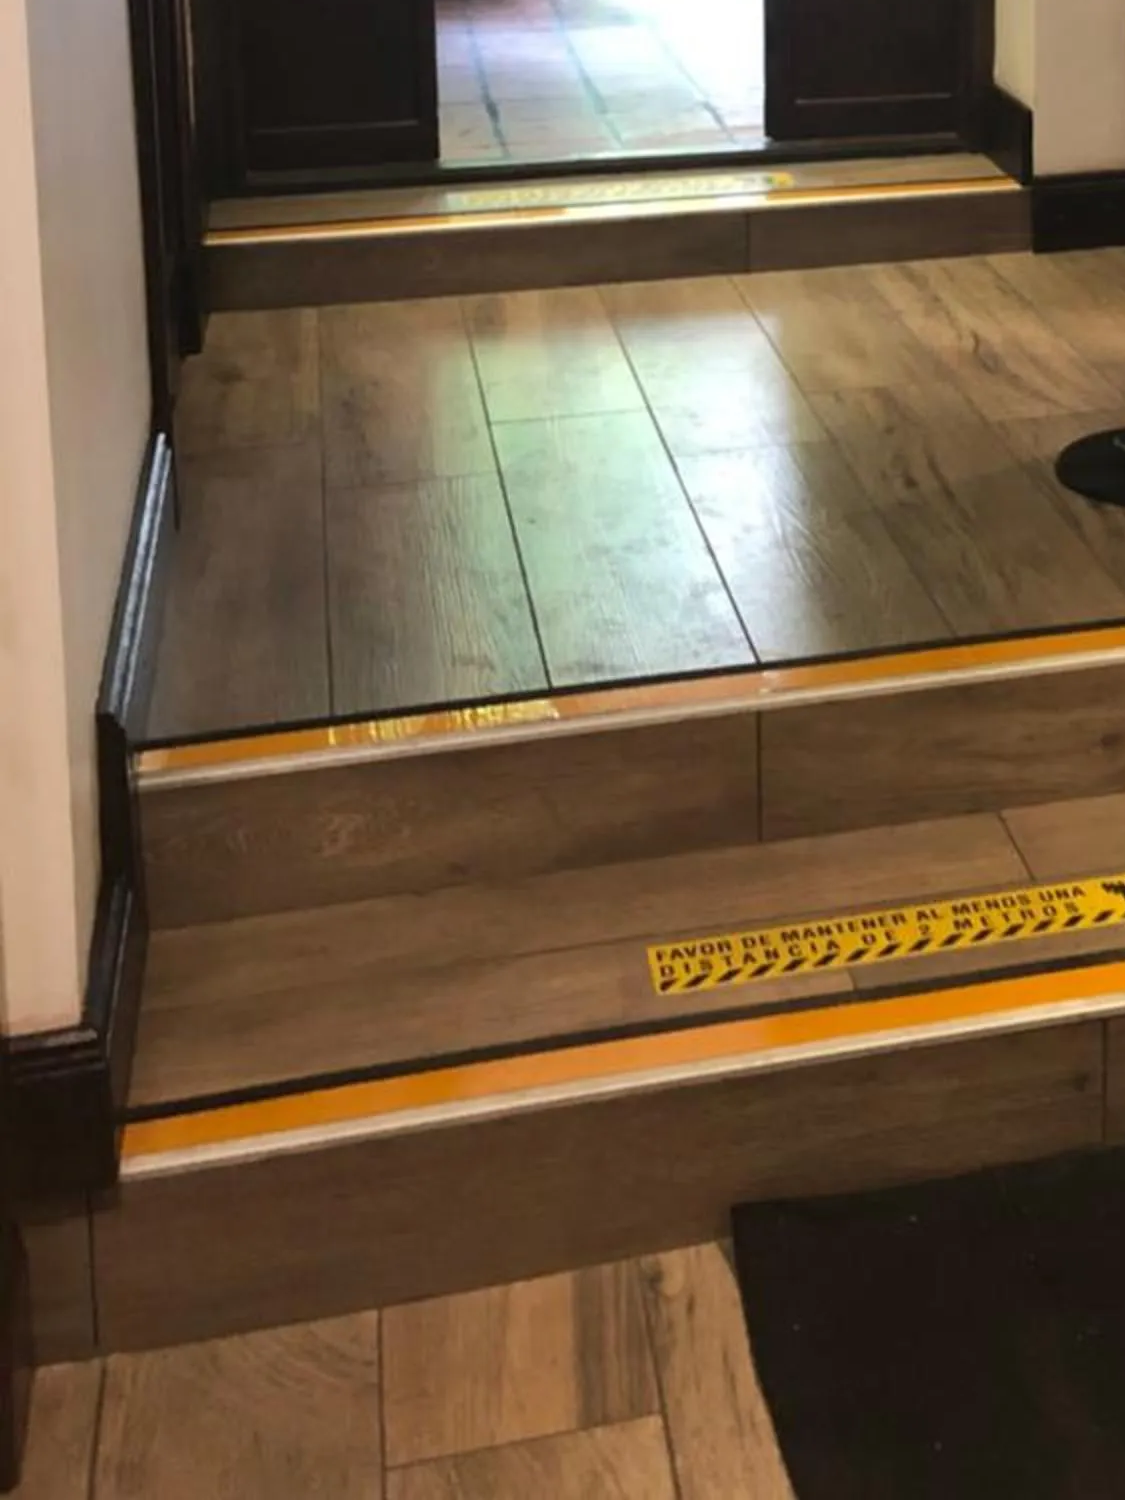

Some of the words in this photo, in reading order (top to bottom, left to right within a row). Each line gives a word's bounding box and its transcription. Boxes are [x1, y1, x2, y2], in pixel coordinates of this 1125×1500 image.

[655, 940, 732, 962] FAVOR
[741, 934, 770, 949] DE
[780, 911, 907, 943] MANTENER
[917, 908, 941, 922] AL
[952, 893, 1032, 916] MENOS
[1040, 885, 1086, 901] UNA
[659, 941, 841, 978] DISTANCIA
[861, 931, 900, 946] DE
[953, 902, 1080, 931] METROS
